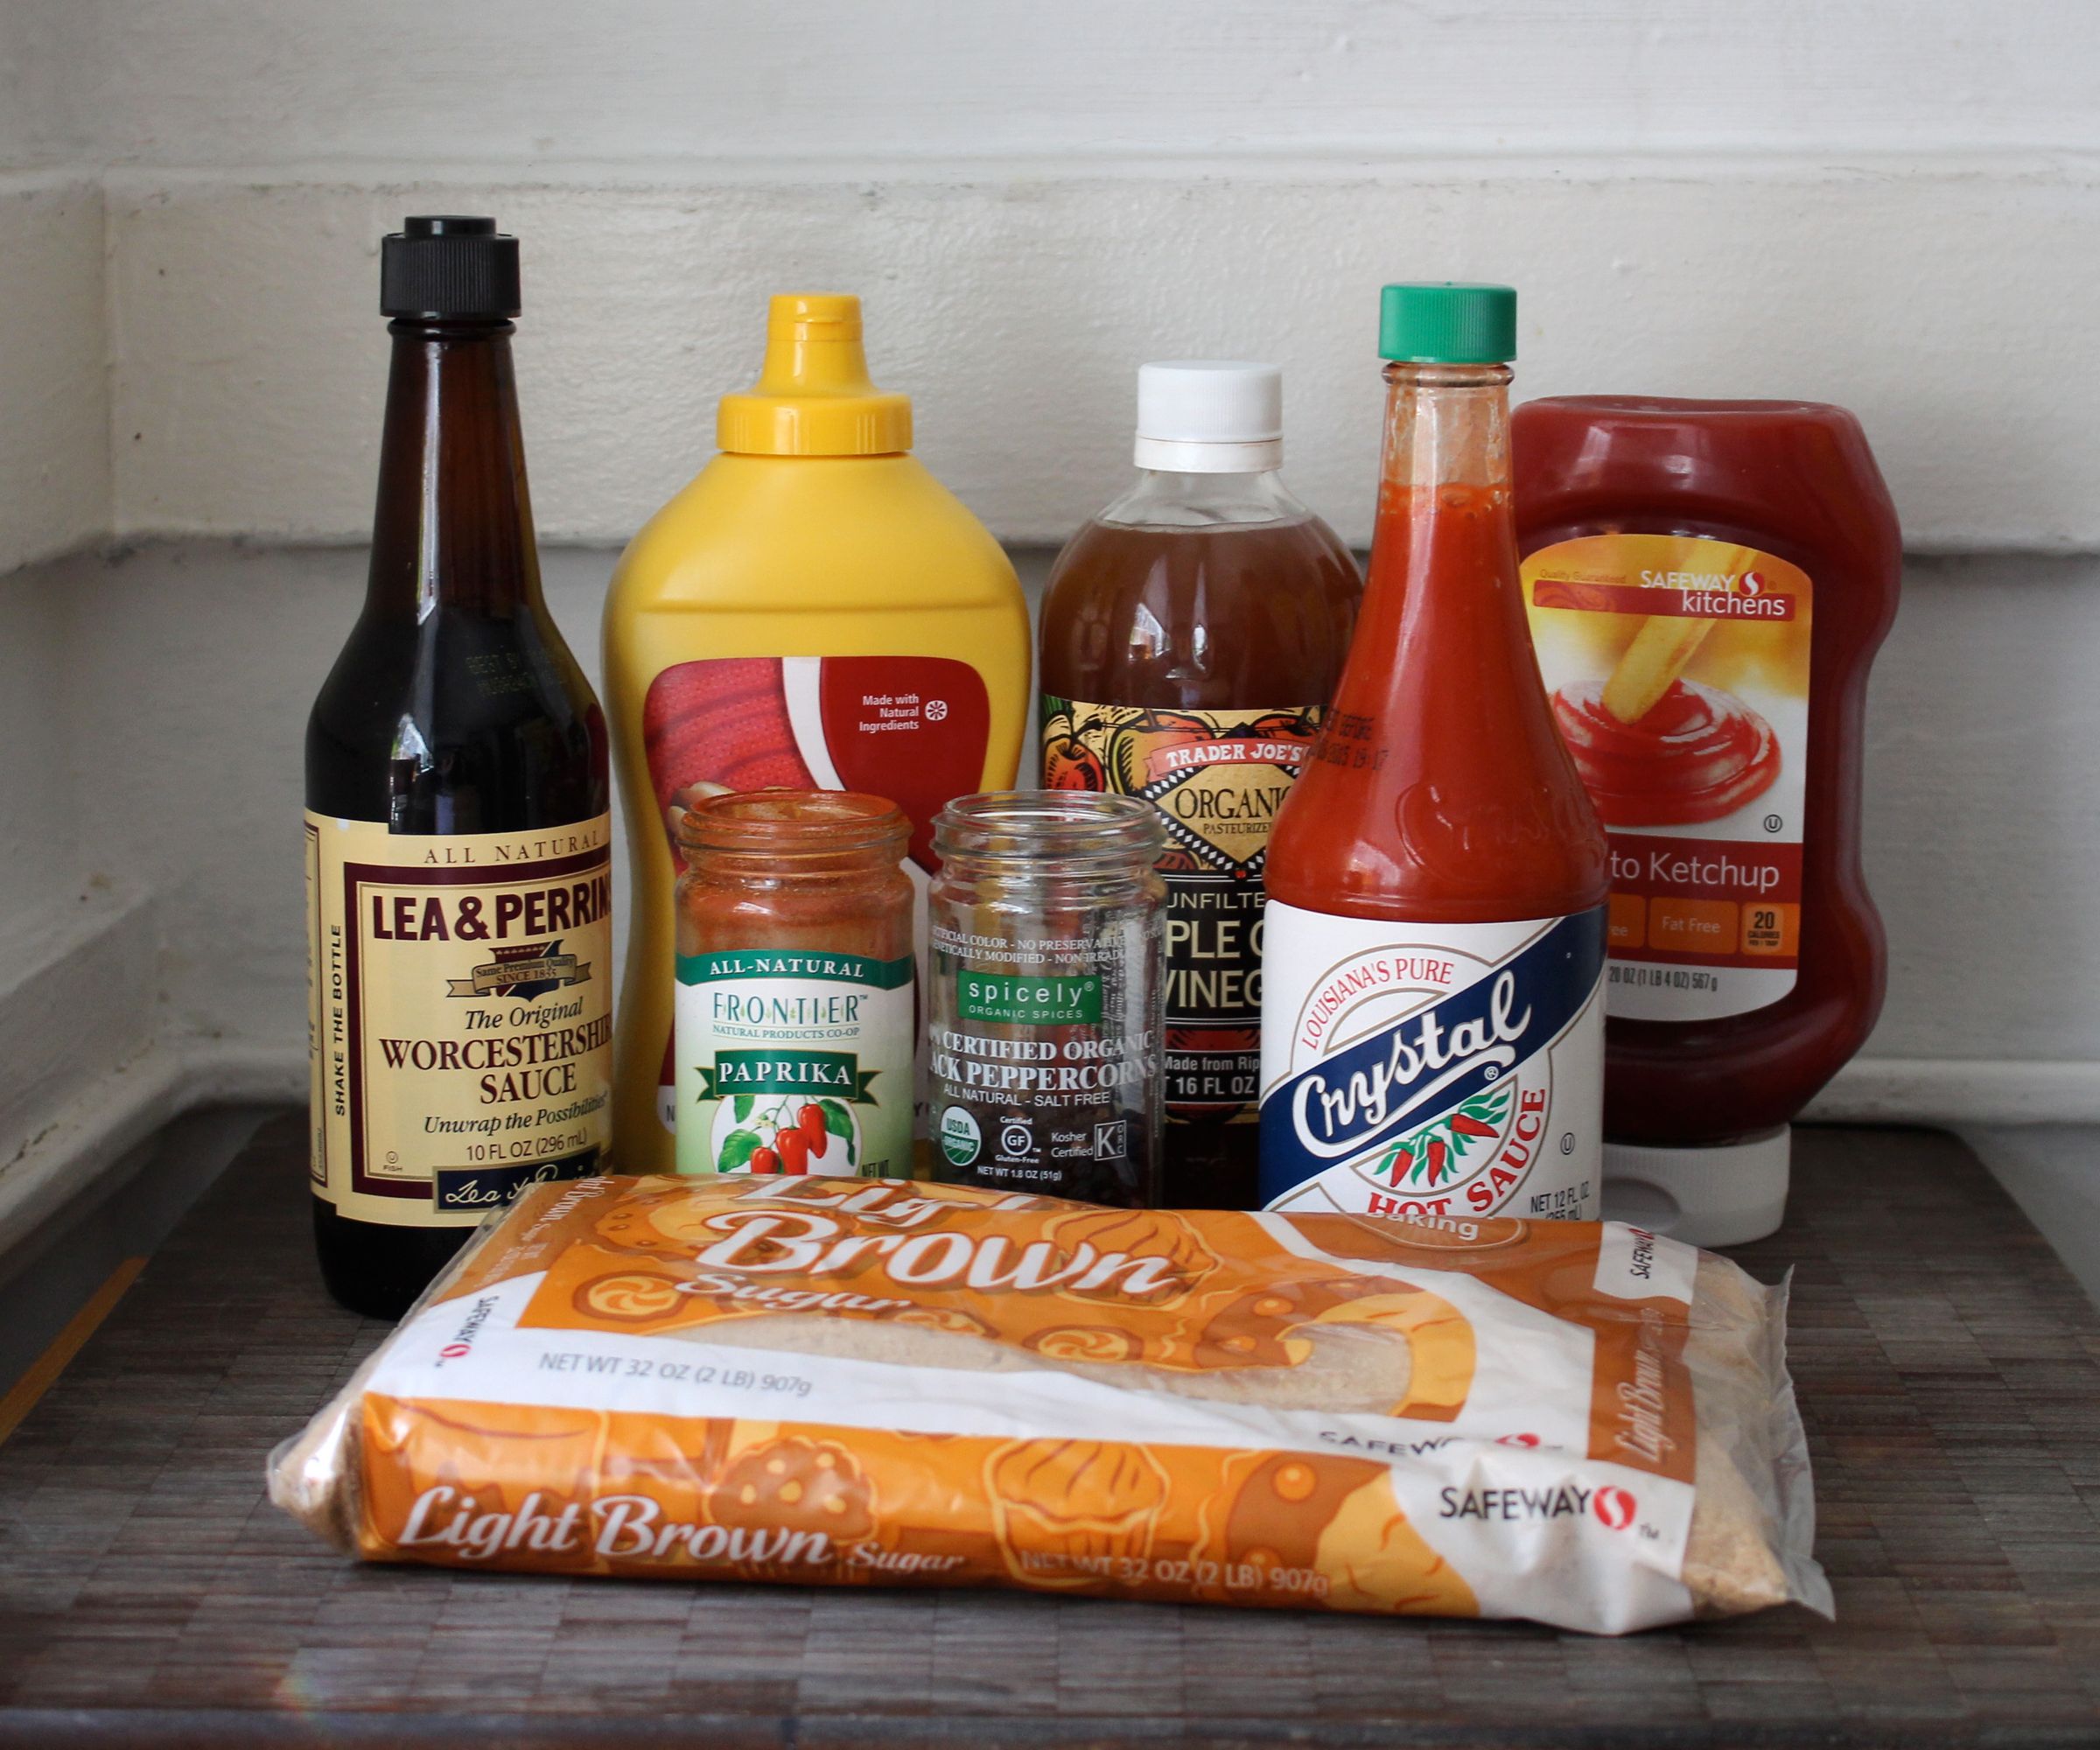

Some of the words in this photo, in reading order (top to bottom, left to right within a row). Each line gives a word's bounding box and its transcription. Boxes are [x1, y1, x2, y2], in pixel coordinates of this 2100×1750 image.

[1641, 570, 1736, 590] SAFEWAY
[1682, 591, 1786, 615] kitchens
[862, 695, 892, 705] Made
[895, 693, 919, 704] with
[879, 706, 919, 718] Natural
[859, 720, 919, 734] Ingredients
[1166, 745, 1246, 766] TRADER
[1250, 744, 1304, 761] JOE'S
[424, 848, 476, 864] ALL
[495, 830, 598, 862] NATURAL
[1648, 851, 1781, 894] Ketchup
[1662, 916, 1684, 931] Fat
[1689, 918, 1721, 934] Free
[1754, 911, 1775, 929] 20
[970, 935, 1008, 949] COLOR
[1017, 939, 1036, 951] NO
[331, 924, 342, 1001] BOTTLE
[710, 958, 864, 978] ALL-NATURAL
[984, 949, 1045, 963] MODIFIED
[496, 970, 531, 984] SINCE
[1609, 966, 1620, 983] 20
[1623, 967, 1635, 984] OZ
[1637, 968, 1647, 987] (1
[1649, 970, 1662, 986] LB
[1664, 971, 1671, 987] 4
[1673, 971, 1690, 990] OZ)
[969, 981, 1082, 1007] spicely
[1302, 959, 1390, 1051] LOUISIANA'S
[1396, 958, 1455, 984] PURE
[466, 1010, 503, 1029] The
[509, 996, 584, 1029] Original
[969, 1005, 1026, 1018] ORGANIC
[1032, 1009, 1083, 1018] SPICES
[333, 1007, 344, 1045] THE
[712, 1025, 761, 1038] NATURAL
[762, 1029, 824, 1039] PRODUCTS
[826, 1027, 860, 1038] CO-OP
[942, 1031, 1058, 1060] CERTIFIED
[1062, 1030, 1153, 1060] ORGANIC
[719, 1061, 852, 1086] PAPRIKA
[930, 1050, 962, 1082] ACK
[966, 1054, 1157, 1091] PEPPERCORNS
[1202, 1056, 1234, 1071] from
[1292, 969, 1532, 1158] Crystal
[334, 1051, 346, 1116] SHAKE
[480, 1062, 578, 1104] SAUCE
[944, 1083, 960, 1098] ALL
[962, 1088, 1022, 1107] NATURAL
[1034, 1094, 1071, 1107] SALT
[1074, 1091, 1110, 1104] FREE
[1176, 1076, 1198, 1096] 16
[1204, 1077, 1225, 1095] FL
[1231, 1076, 1256, 1095] OZ
[424, 1115, 501, 1136] Unwrap
[506, 1111, 532, 1130] the
[946, 1117, 970, 1136] USDA
[999, 1116, 1033, 1125] Certified
[466, 1144, 485, 1161] 10
[489, 1143, 507, 1160] FL
[510, 1139, 532, 1158] OZ
[536, 1133, 564, 1157] (296
[567, 1127, 588, 1148] mL)
[1007, 1134, 1026, 1147] GF
[1051, 1130, 1088, 1143] Kosher
[995, 1153, 1040, 1165] Gluten-Free
[1051, 1144, 1094, 1158] Certified
[1368, 1192, 1452, 1215] HOT
[1467, 1088, 1547, 1213] SAUCE
[977, 1166, 994, 1176] NET
[996, 1167, 1010, 1177] WT
[1011, 1168, 1024, 1178] 1.8
[1026, 1169, 1039, 1180] OZ
[1040, 1169, 1063, 1181] (51g)
[1531, 1194, 1552, 1214] NET
[1554, 1190, 1566, 1208] 12
[696, 1209, 1182, 1294] Brown
[674, 1274, 912, 1310] Sugar
[539, 1352, 584, 1371] NET
[586, 1355, 624, 1374] WT
[625, 1358, 654, 1377] 32
[659, 1362, 692, 1381] OZ
[694, 1365, 718, 1385] (2
[721, 1369, 756, 1390] LB)
[760, 1374, 813, 1398] 907g
[1438, 1484, 1592, 1523] SAFEWAY
[398, 1485, 580, 1559] Light
[592, 1494, 834, 1564] Brown
[845, 1542, 966, 1573] Sugar
[1072, 1554, 1114, 1576] WT
[1118, 1556, 1150, 1580] 32
[1153, 1559, 1192, 1584] OZ
[1195, 1560, 1221, 1586] (2
[1225, 1563, 1264, 1591] LB)
[1269, 1565, 1330, 1599] 907g
